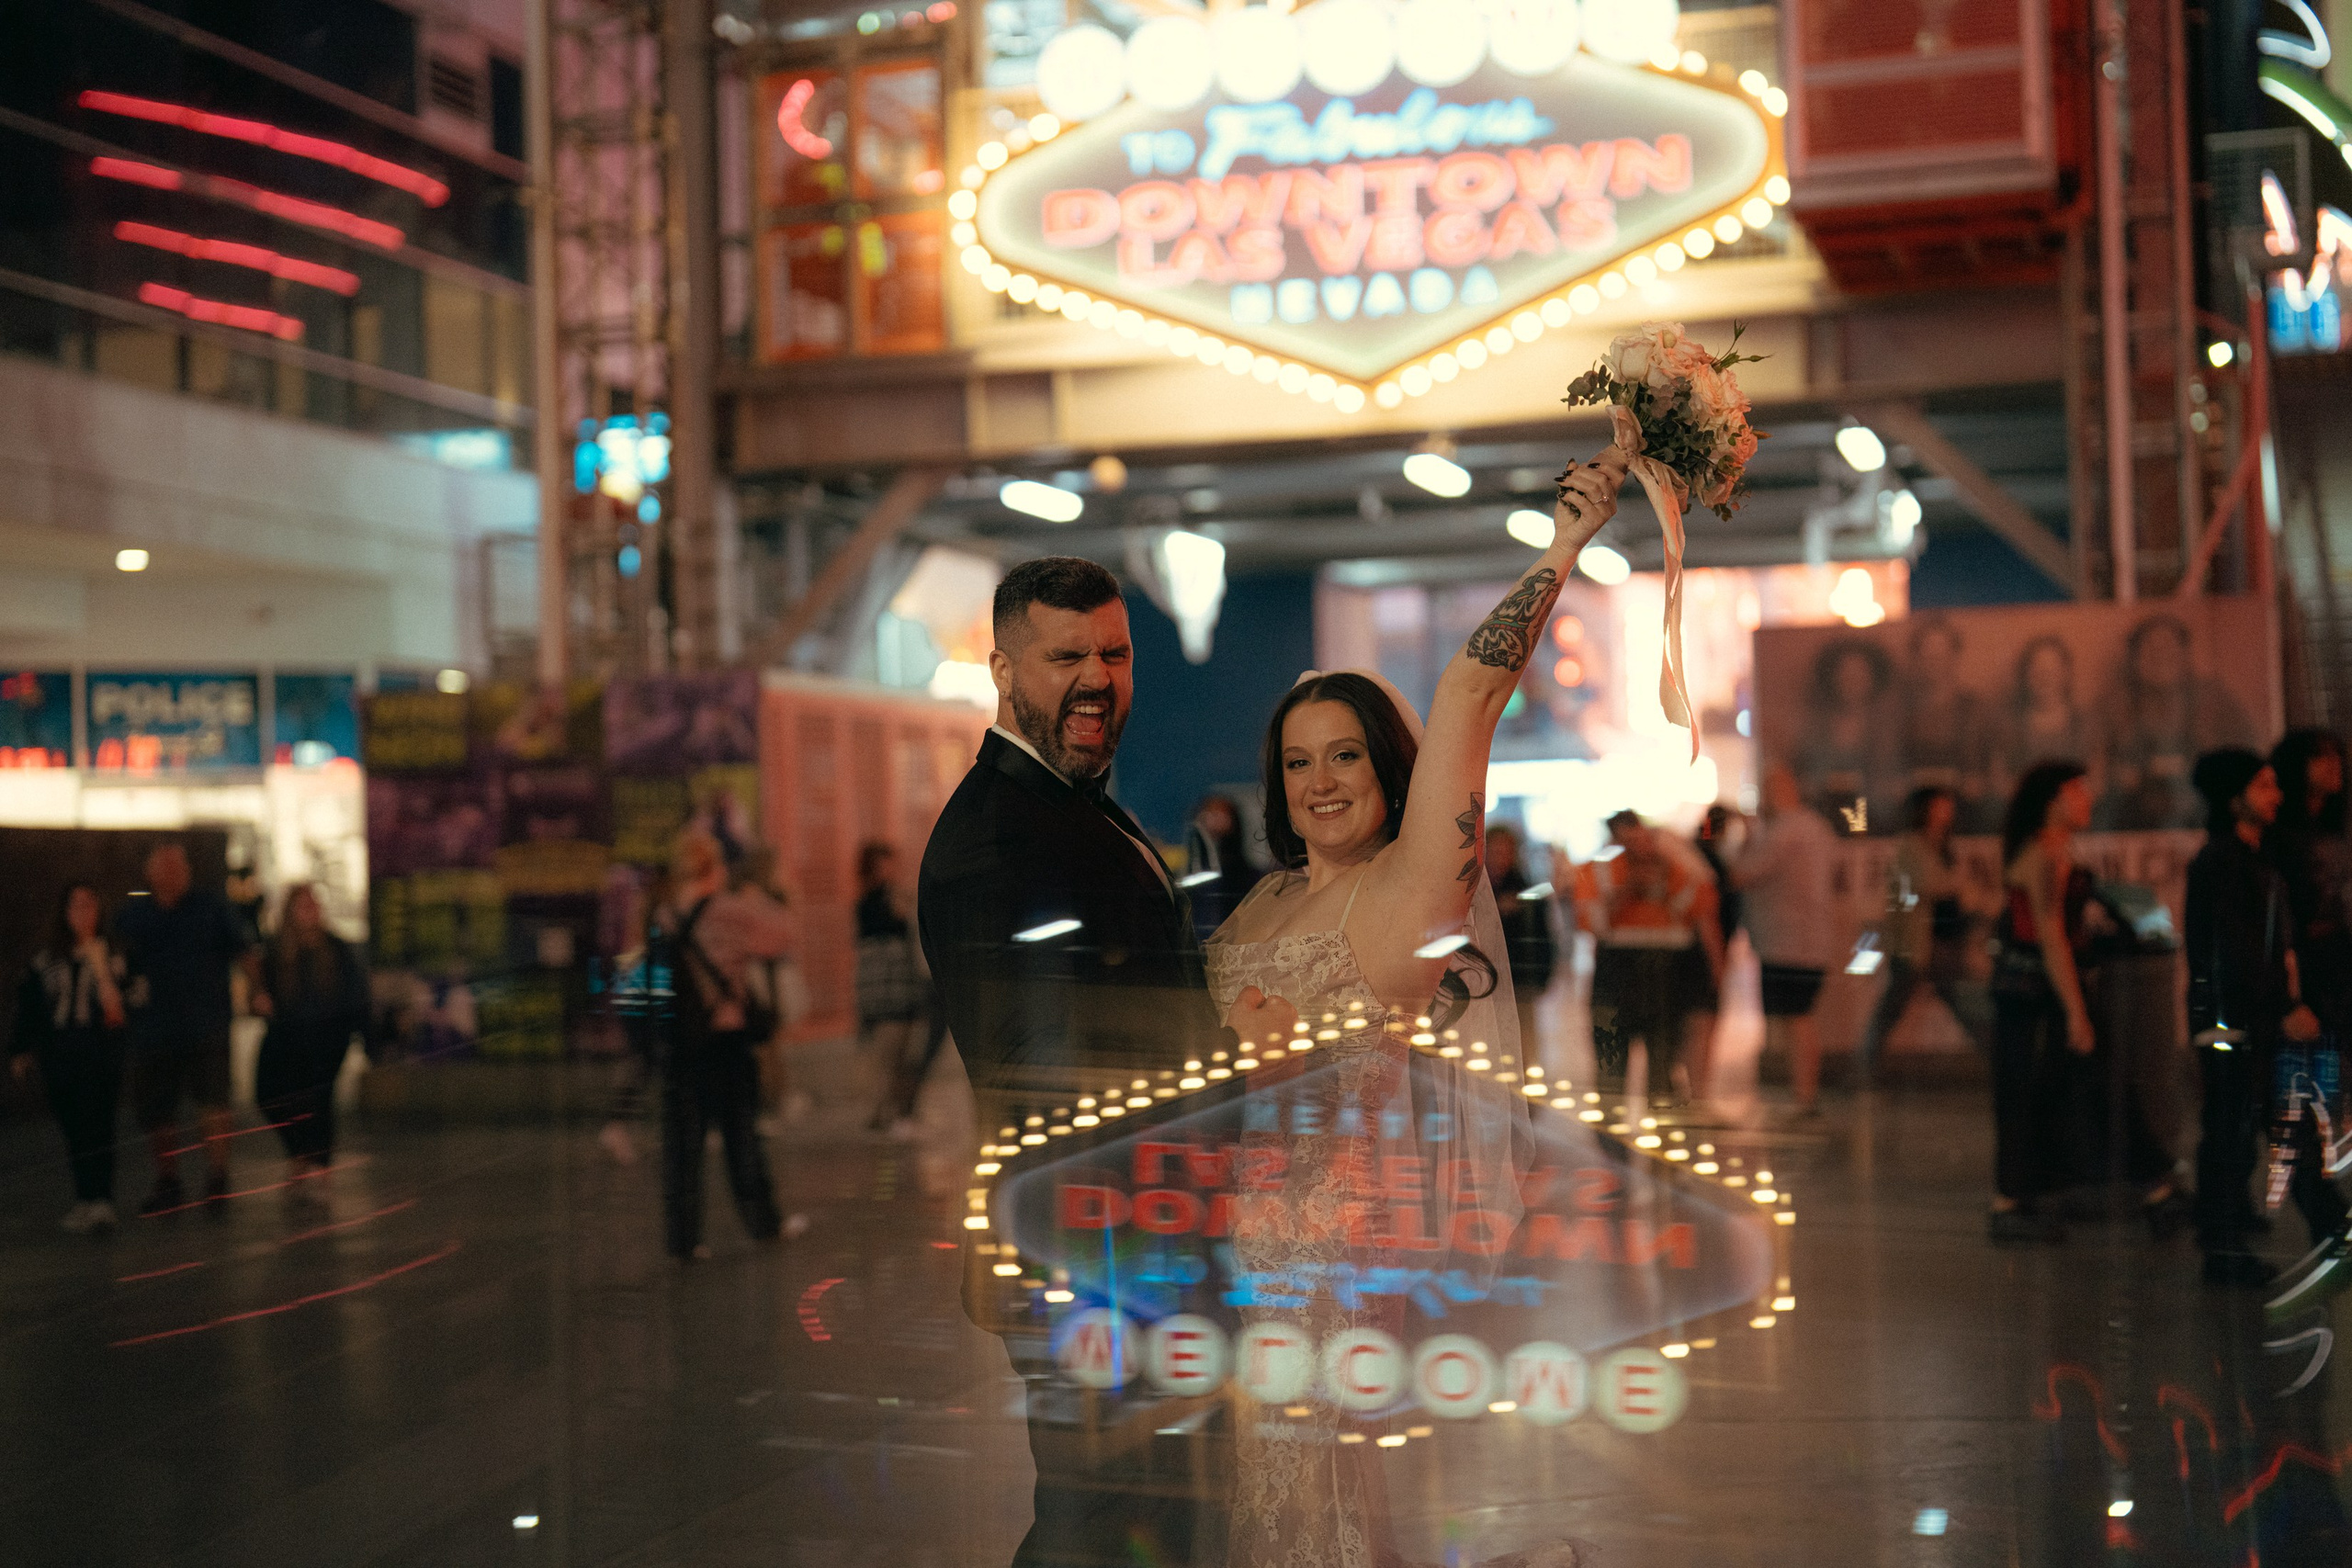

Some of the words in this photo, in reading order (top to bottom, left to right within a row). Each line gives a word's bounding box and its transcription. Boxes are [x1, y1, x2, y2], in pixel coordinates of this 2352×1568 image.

[1041, 133, 1693, 246] DOWNTOWN
[1116, 226, 1284, 286] LAS
[1303, 198, 1618, 276] VEGAS
[1229, 265, 1499, 324] NEVADA
[93, 682, 254, 727] POLICE
